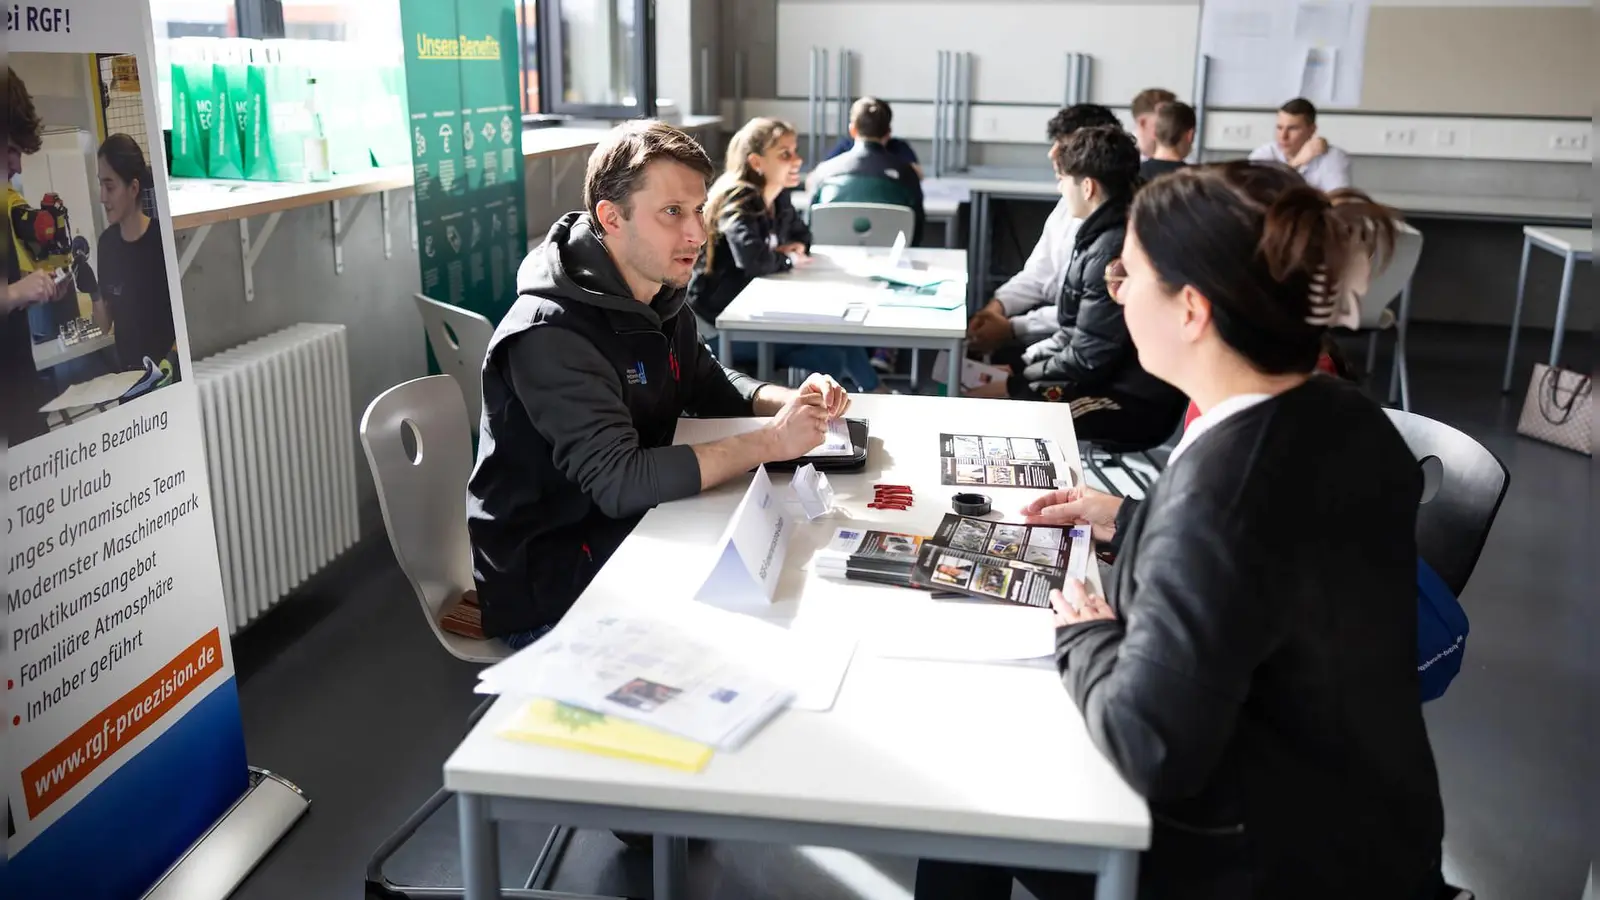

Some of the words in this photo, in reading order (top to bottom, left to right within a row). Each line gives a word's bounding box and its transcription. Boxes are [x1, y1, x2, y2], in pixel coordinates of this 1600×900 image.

[27, 6, 70, 33] RGF!
[416, 32, 458, 57] Unsere
[9, 442, 97, 492] ertarifliche
[101, 411, 168, 453] Bezahlung
[17, 498, 55, 528] Tage
[61, 469, 111, 507] Urlaub
[59, 487, 151, 547] dynamisches
[153, 470, 185, 496] Team
[8, 551, 99, 615] Modernster
[103, 492, 199, 562] Maschinenpark
[13, 551, 157, 651] Praktikumsangebot
[21, 629, 90, 687] Familiäre
[94, 576, 174, 639] Atmosphäre
[27, 668, 86, 723] Inhaber
[90, 629, 143, 683] geführt
[35, 645, 215, 797] www.rgf-praezision.de
